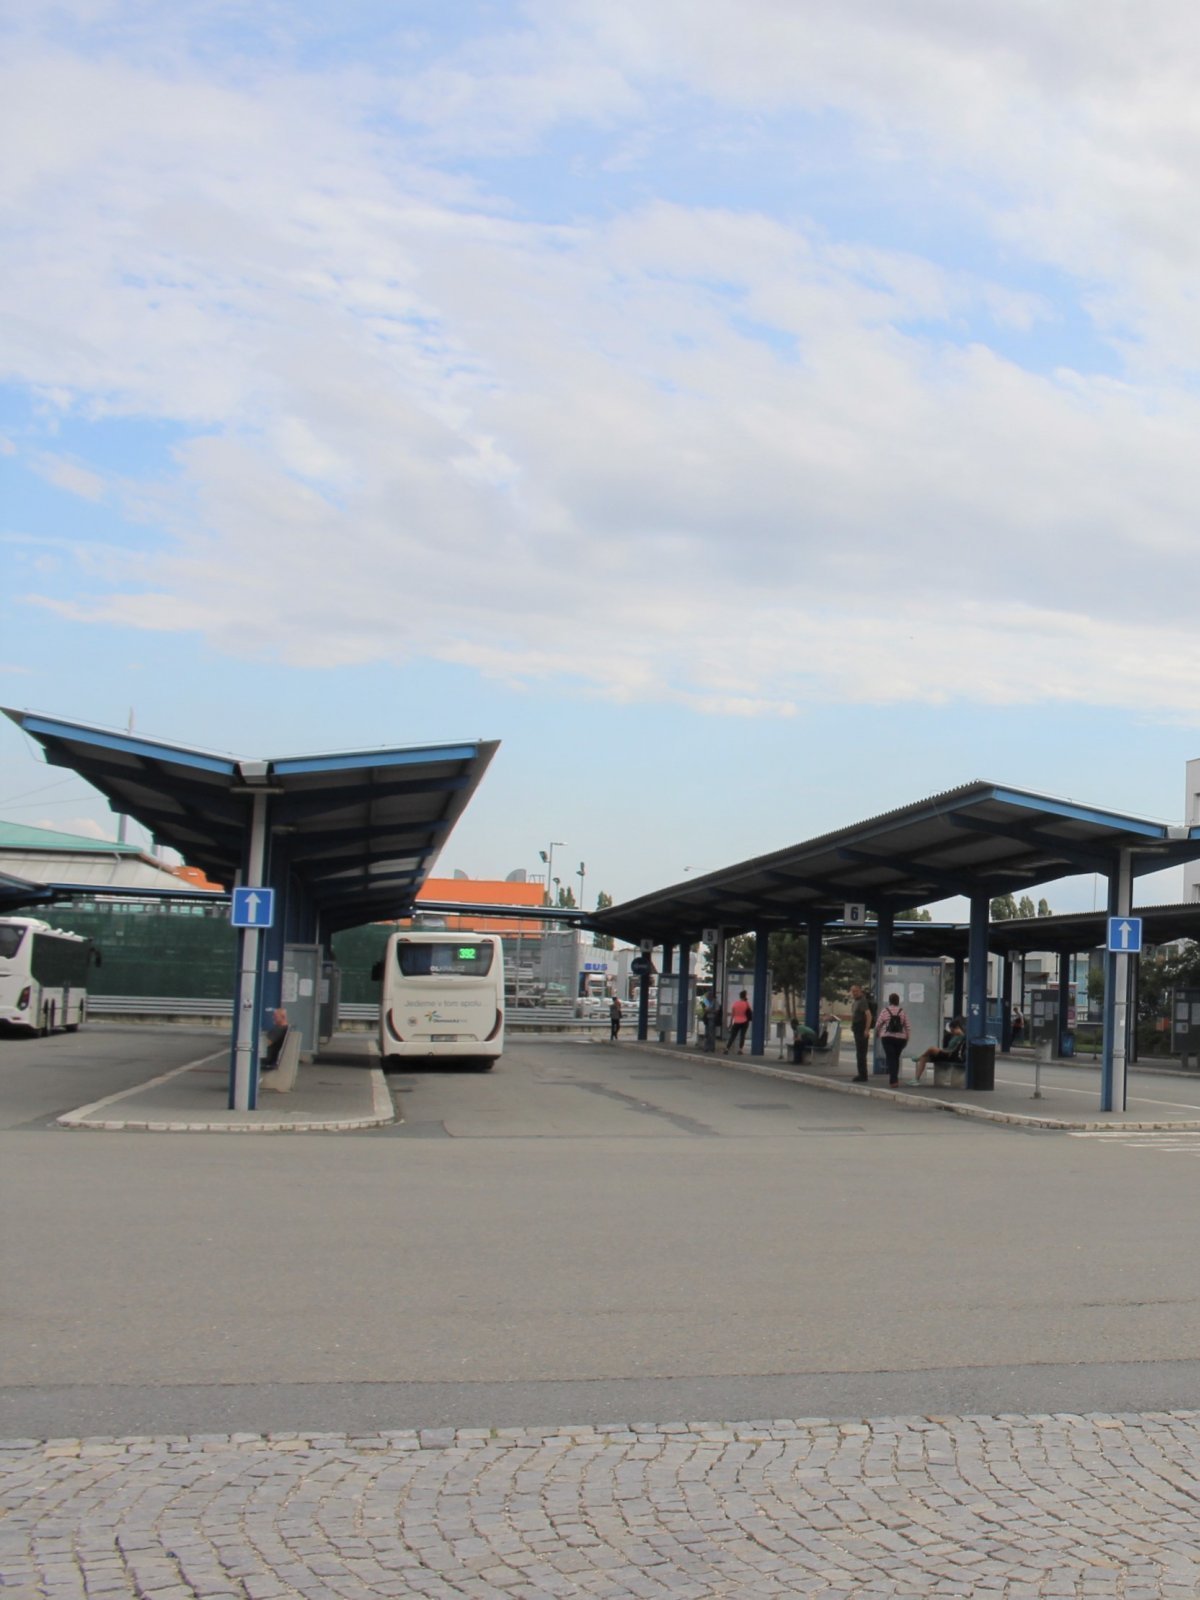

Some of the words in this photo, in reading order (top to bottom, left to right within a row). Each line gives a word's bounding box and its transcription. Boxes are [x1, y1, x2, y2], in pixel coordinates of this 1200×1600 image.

[850, 906, 859, 921] 6
[707, 931, 714, 942] 5
[459, 948, 476, 959] 392
[584, 962, 608, 971] BUS
